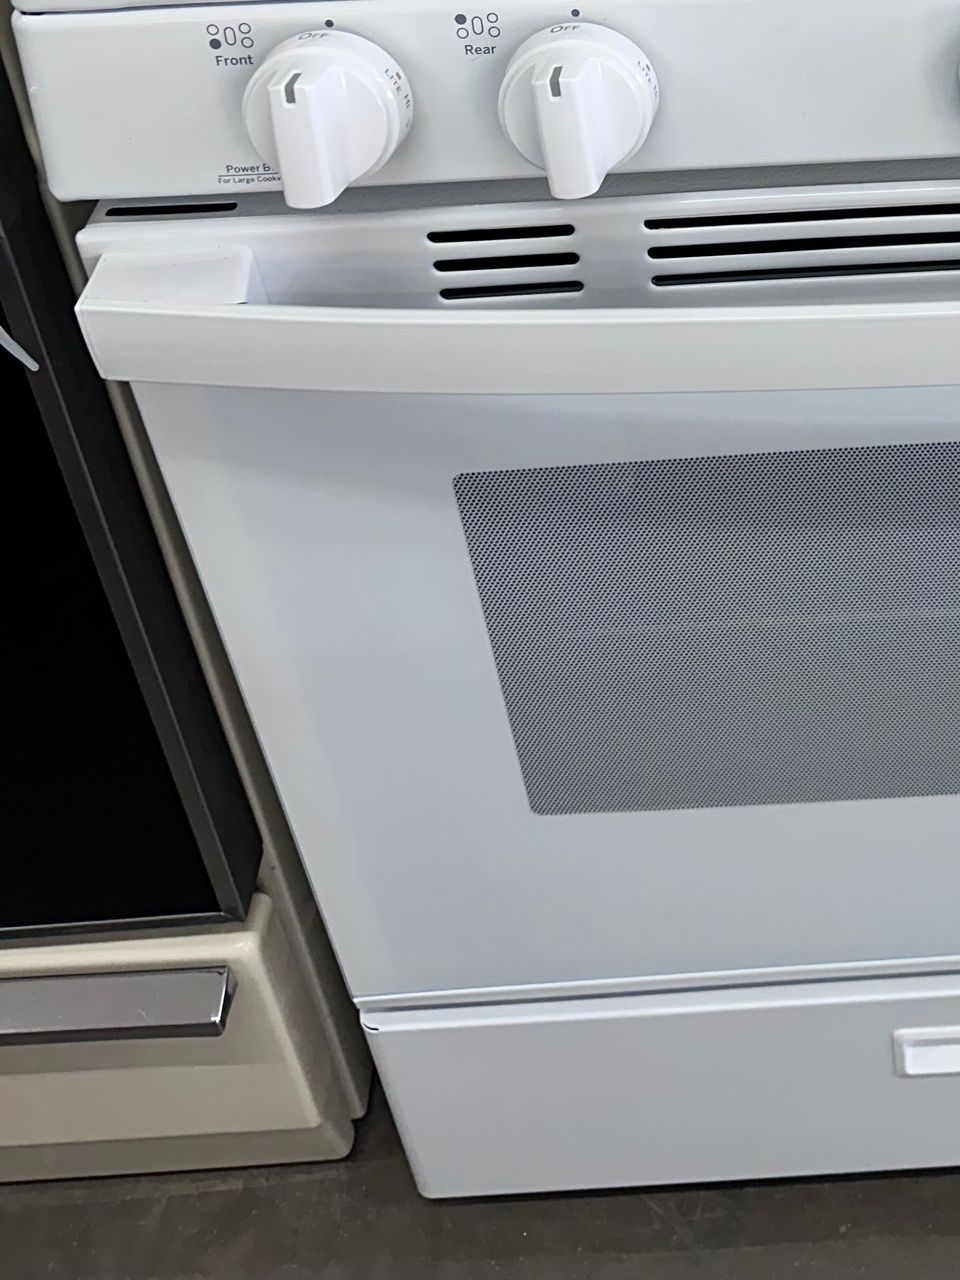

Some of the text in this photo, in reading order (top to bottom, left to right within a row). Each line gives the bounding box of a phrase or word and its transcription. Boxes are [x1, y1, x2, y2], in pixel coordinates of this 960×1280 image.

[550, 24, 580, 33] OFF
[298, 32, 330, 40] OFF
[464, 44, 497, 55] Rear
[215, 54, 254, 66] Front
[226, 164, 260, 174] Power
[218, 177, 232, 185] For
[233, 176, 255, 185] Large
